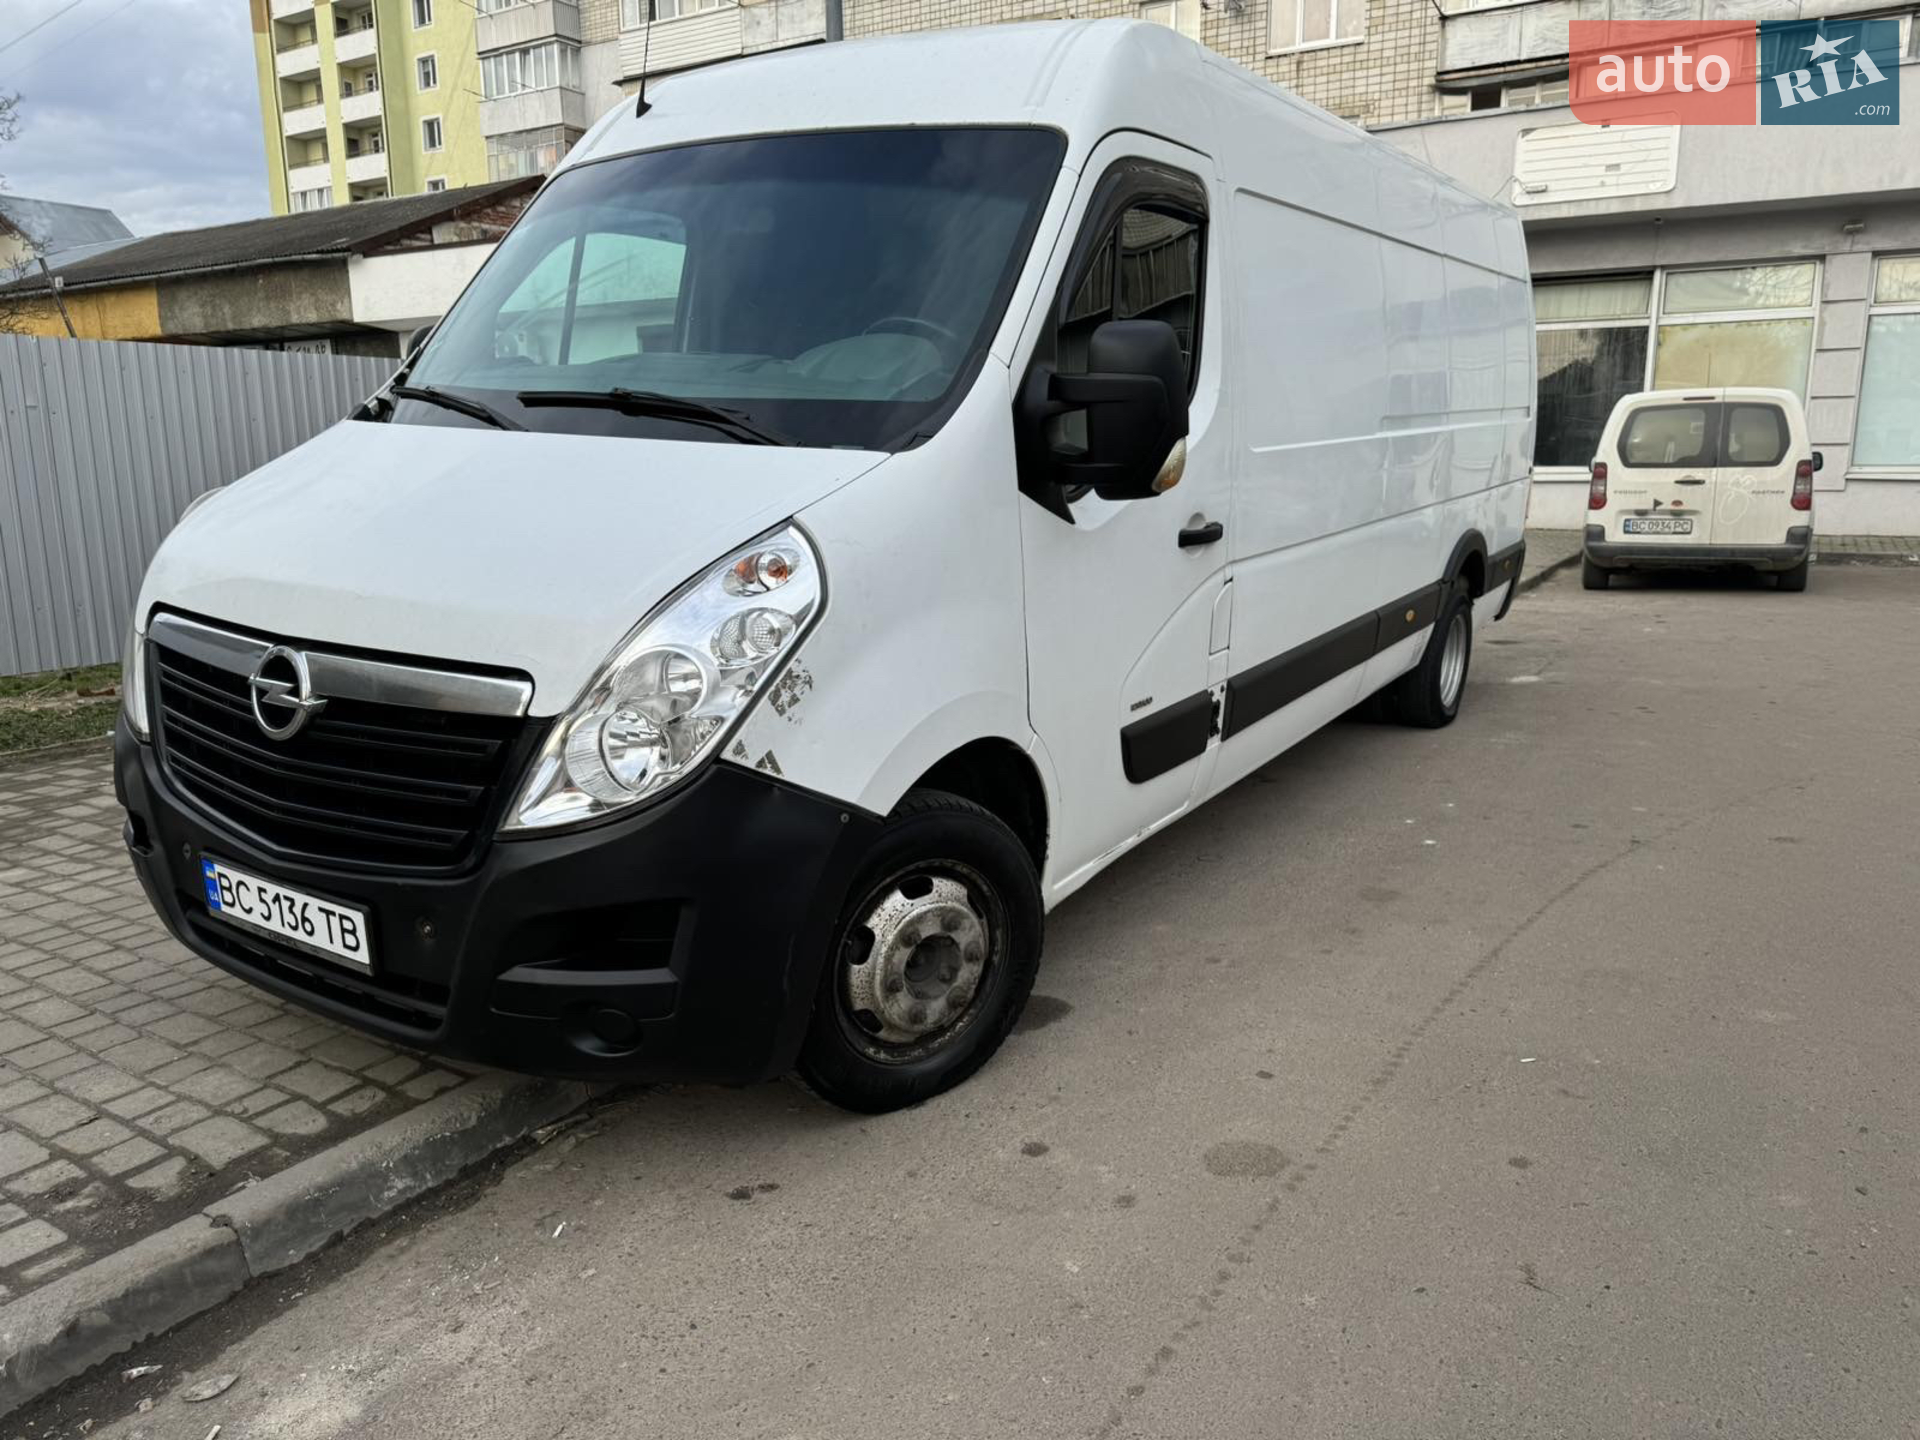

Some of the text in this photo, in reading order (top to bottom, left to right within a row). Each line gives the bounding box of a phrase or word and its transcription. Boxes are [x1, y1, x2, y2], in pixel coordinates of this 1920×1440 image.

[216, 871, 361, 952] BC 5136 TB
